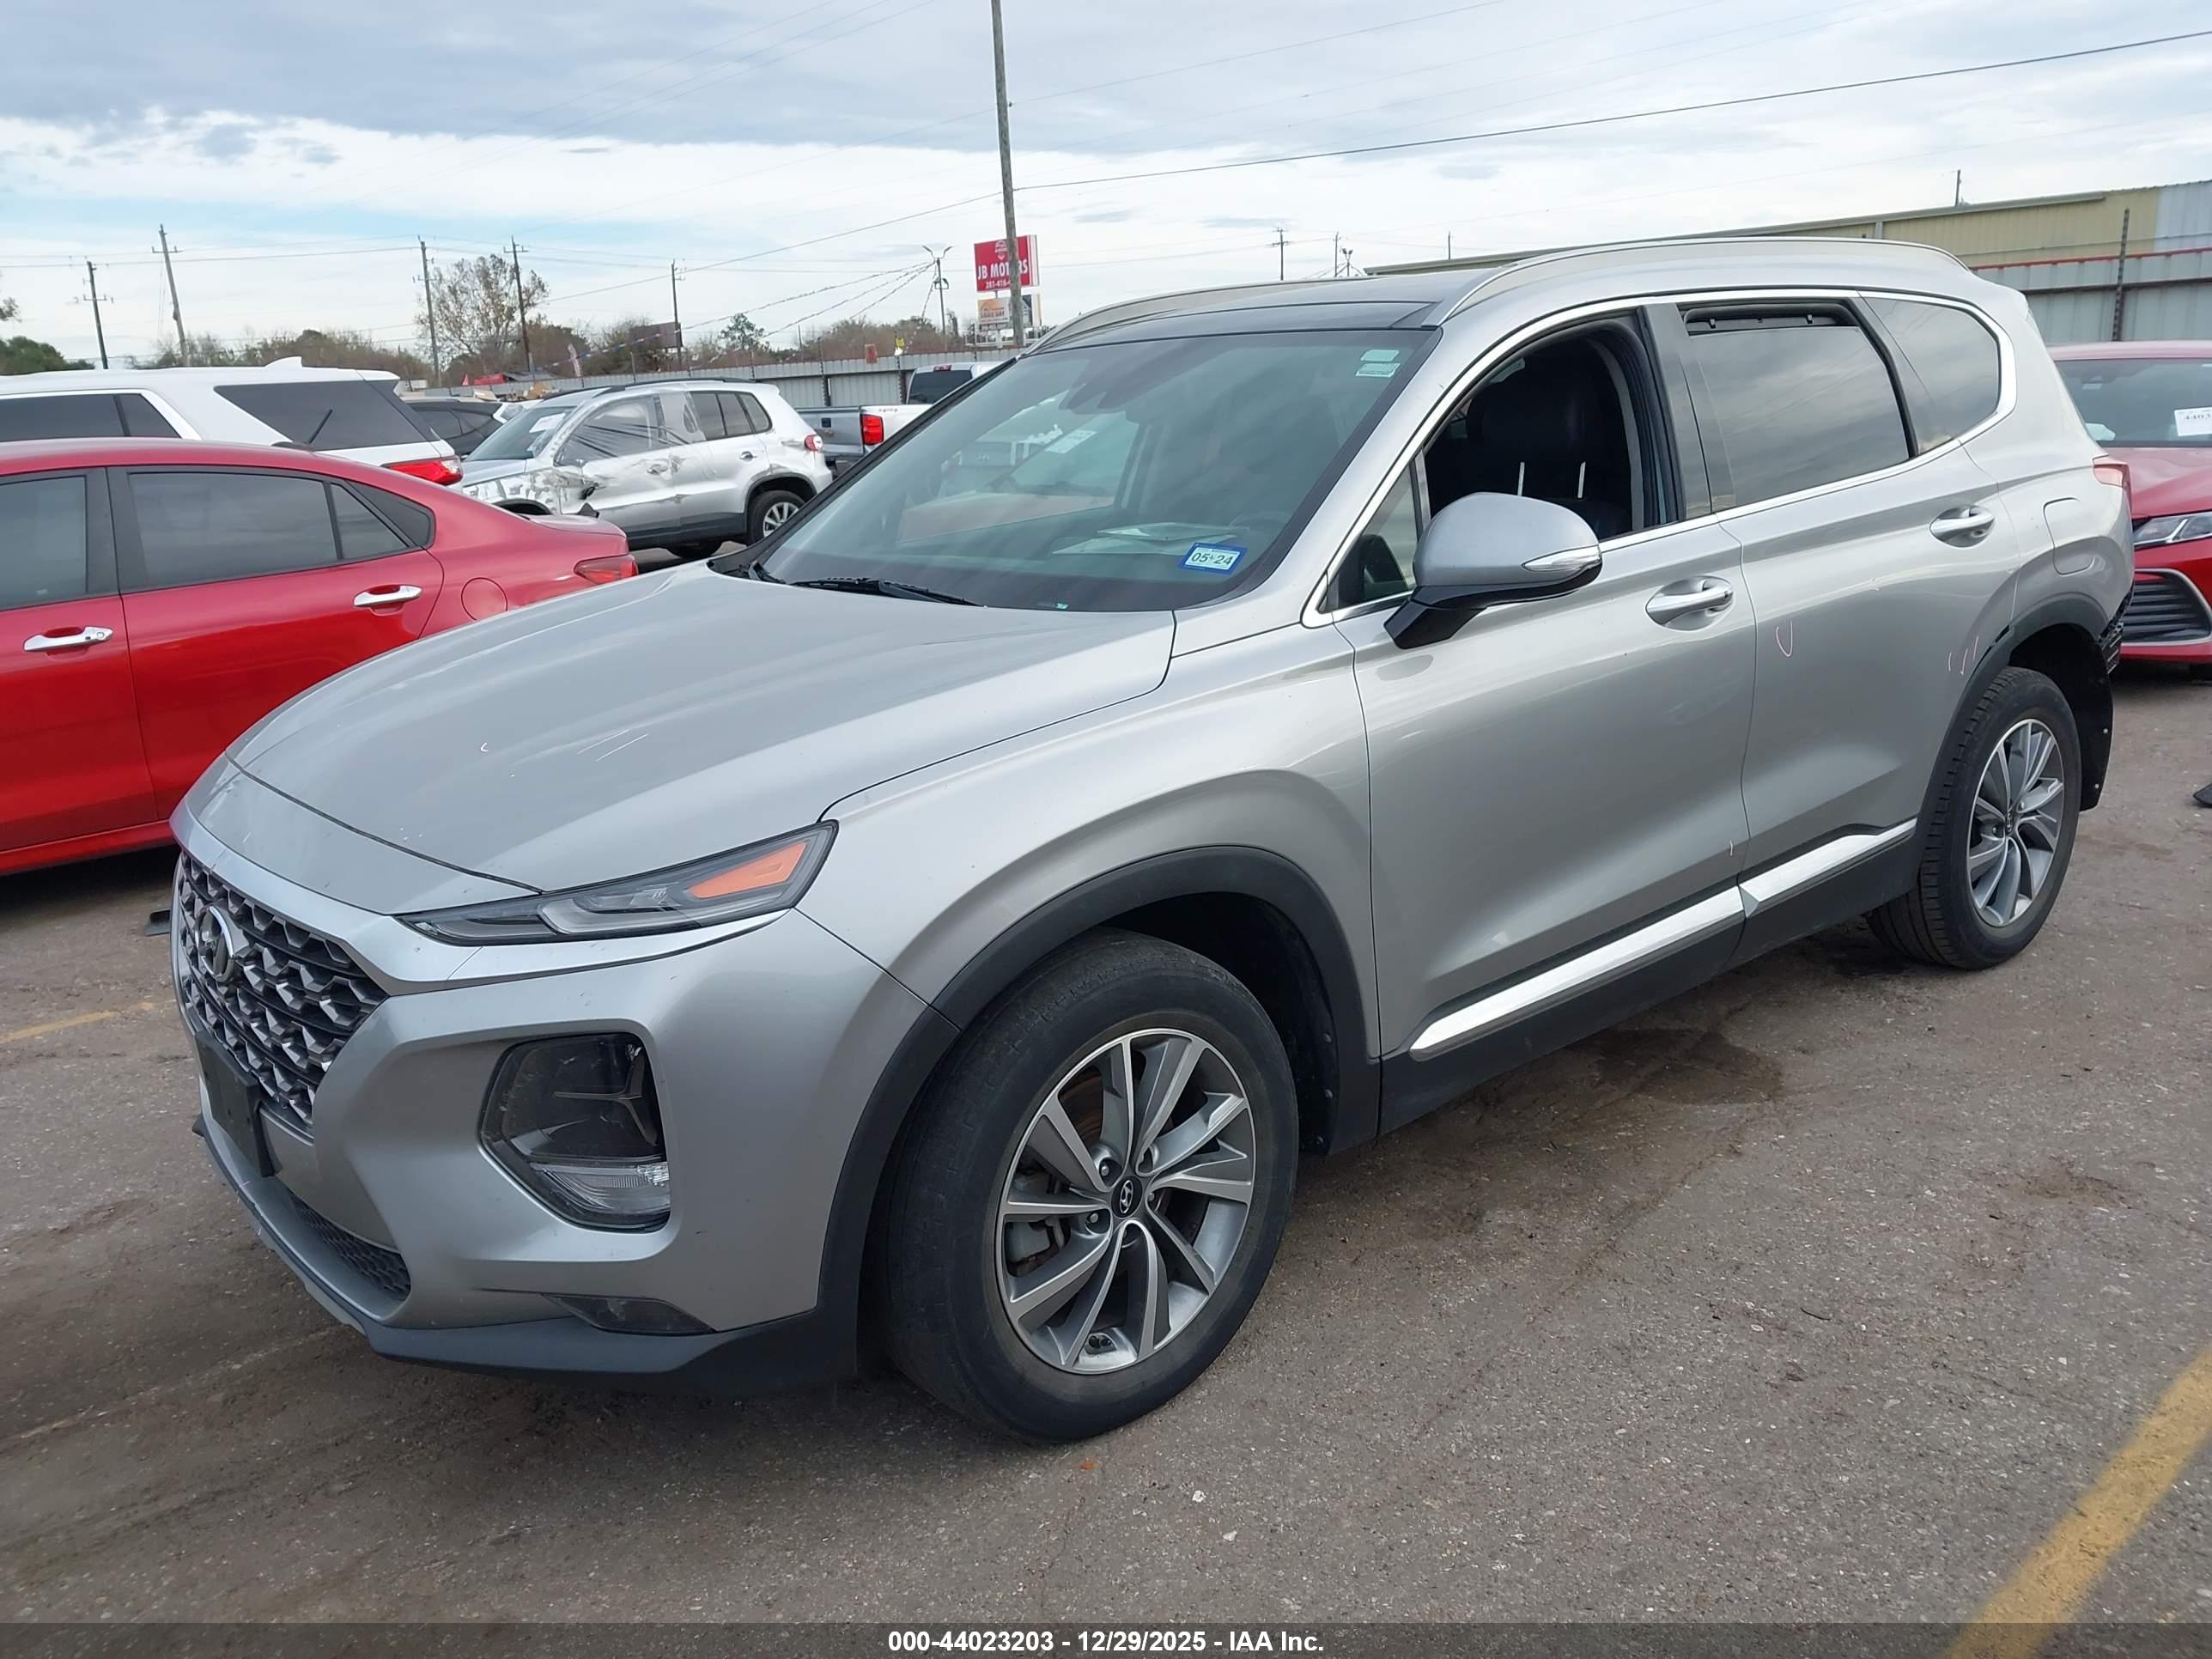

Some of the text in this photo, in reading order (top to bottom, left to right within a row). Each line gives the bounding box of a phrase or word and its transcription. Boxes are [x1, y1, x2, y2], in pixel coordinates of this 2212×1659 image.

[977, 258, 1029, 280] JB MOTRS
[1191, 552, 1234, 566] 05 24
